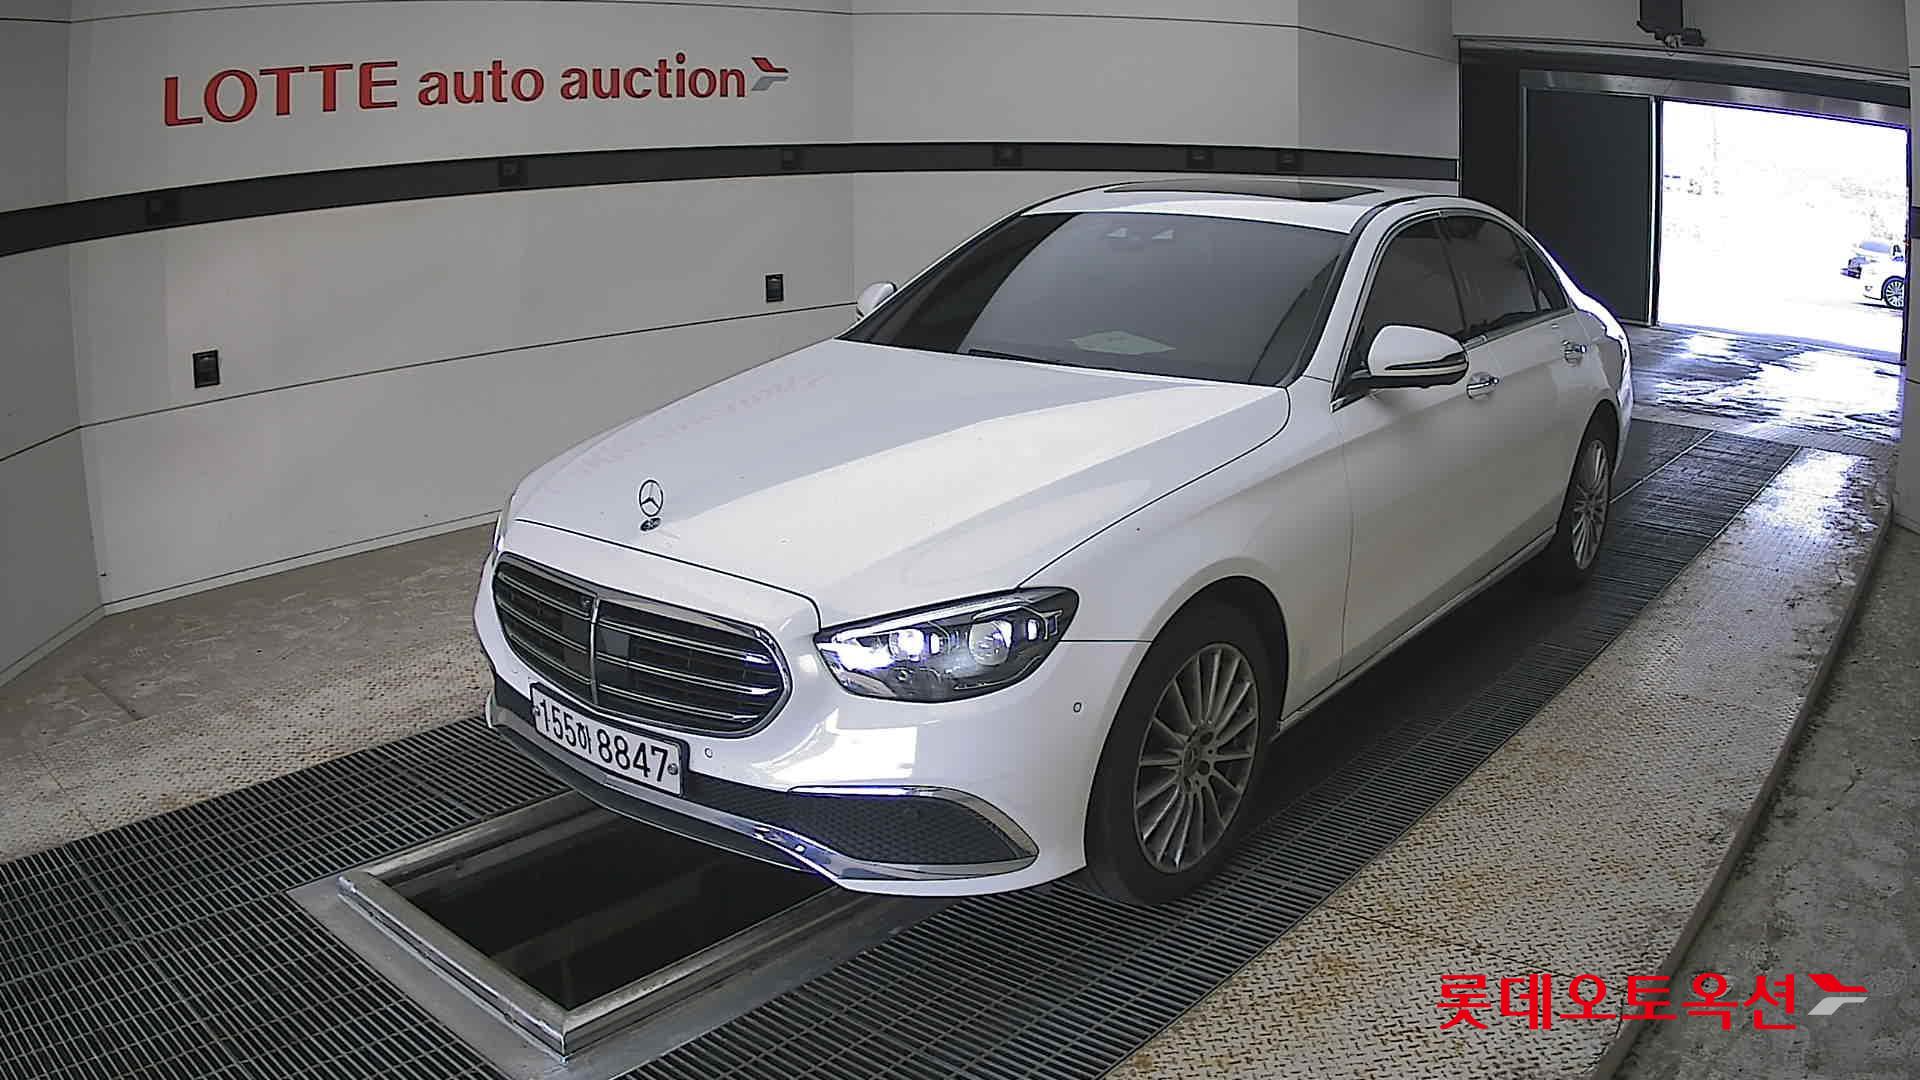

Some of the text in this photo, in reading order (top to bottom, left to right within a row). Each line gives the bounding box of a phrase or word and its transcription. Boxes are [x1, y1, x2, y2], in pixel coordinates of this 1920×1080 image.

[163, 52, 747, 127] LOTTE auto auction
[596, 728, 669, 782] 8847
